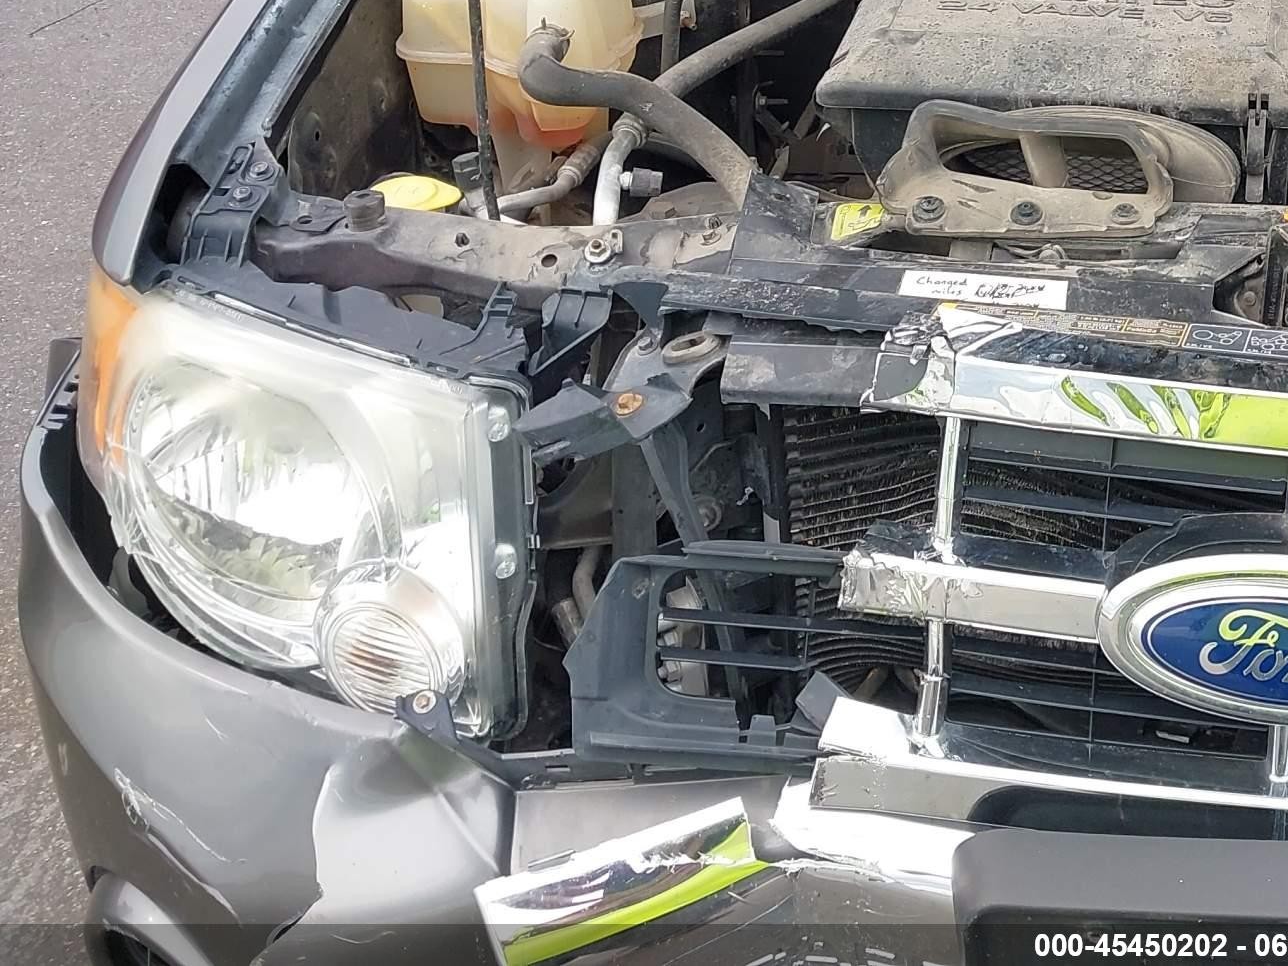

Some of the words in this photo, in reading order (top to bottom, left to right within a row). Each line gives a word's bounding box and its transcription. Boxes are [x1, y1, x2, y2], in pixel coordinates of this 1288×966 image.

[937, 0, 998, 13] 24
[1011, 2, 1145, 20] VALVE
[1173, 9, 1233, 23] V6
[916, 276, 968, 288] Changed
